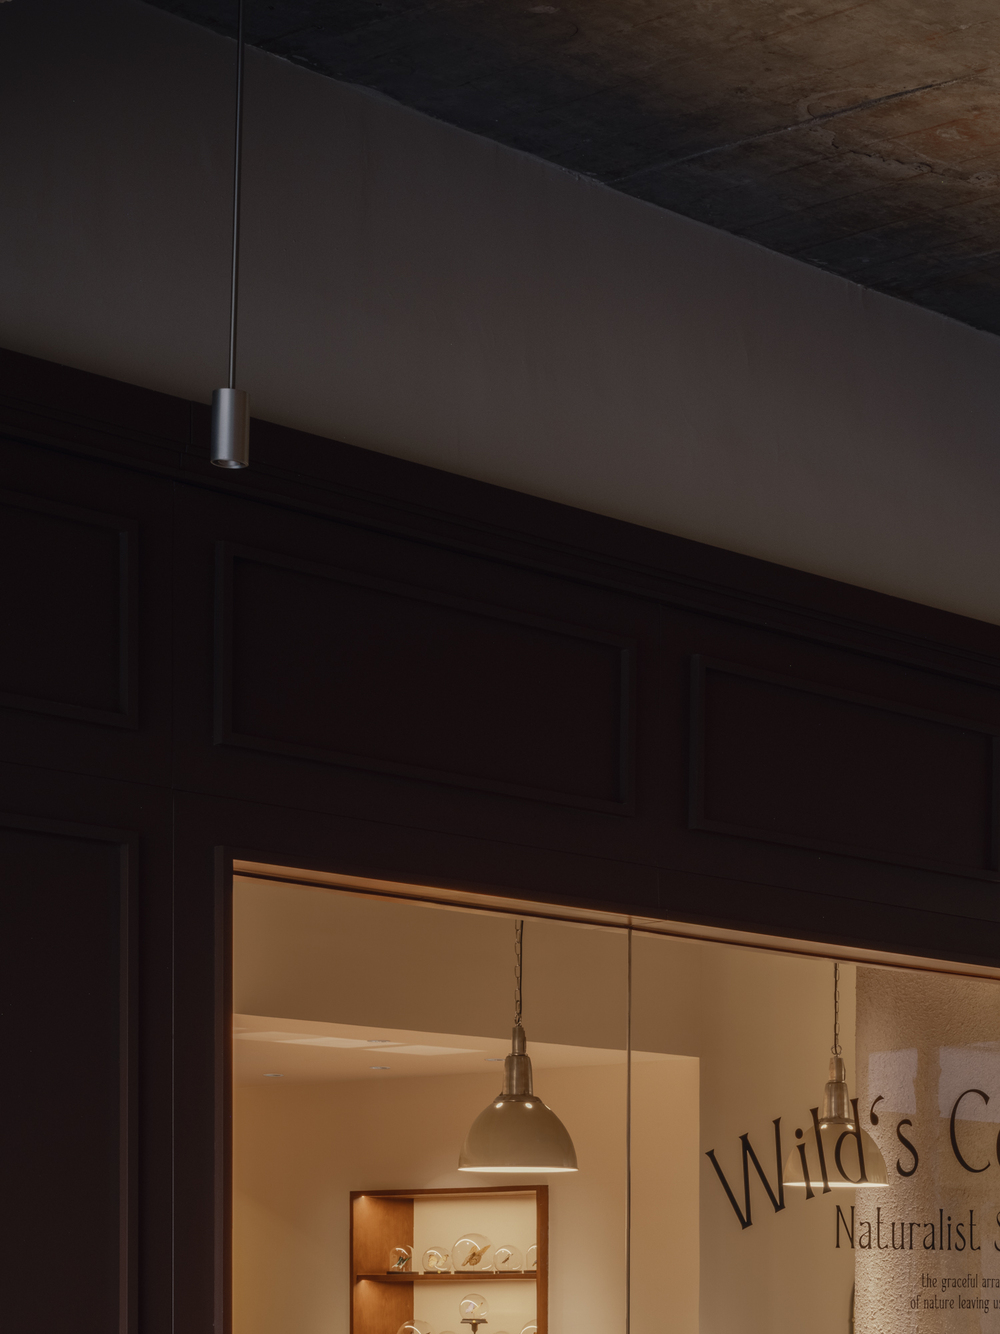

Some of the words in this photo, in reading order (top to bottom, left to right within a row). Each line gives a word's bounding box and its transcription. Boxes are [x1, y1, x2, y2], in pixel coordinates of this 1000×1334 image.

[705, 1095, 919, 1230] Wild's
[835, 1205, 981, 1251] Naturalist
[921, 1273, 937, 1288] the
[941, 1273, 978, 1293] graceful
[910, 1295, 921, 1310] of
[923, 1294, 955, 1310] nature
[958, 1295, 990, 1314] leaving
